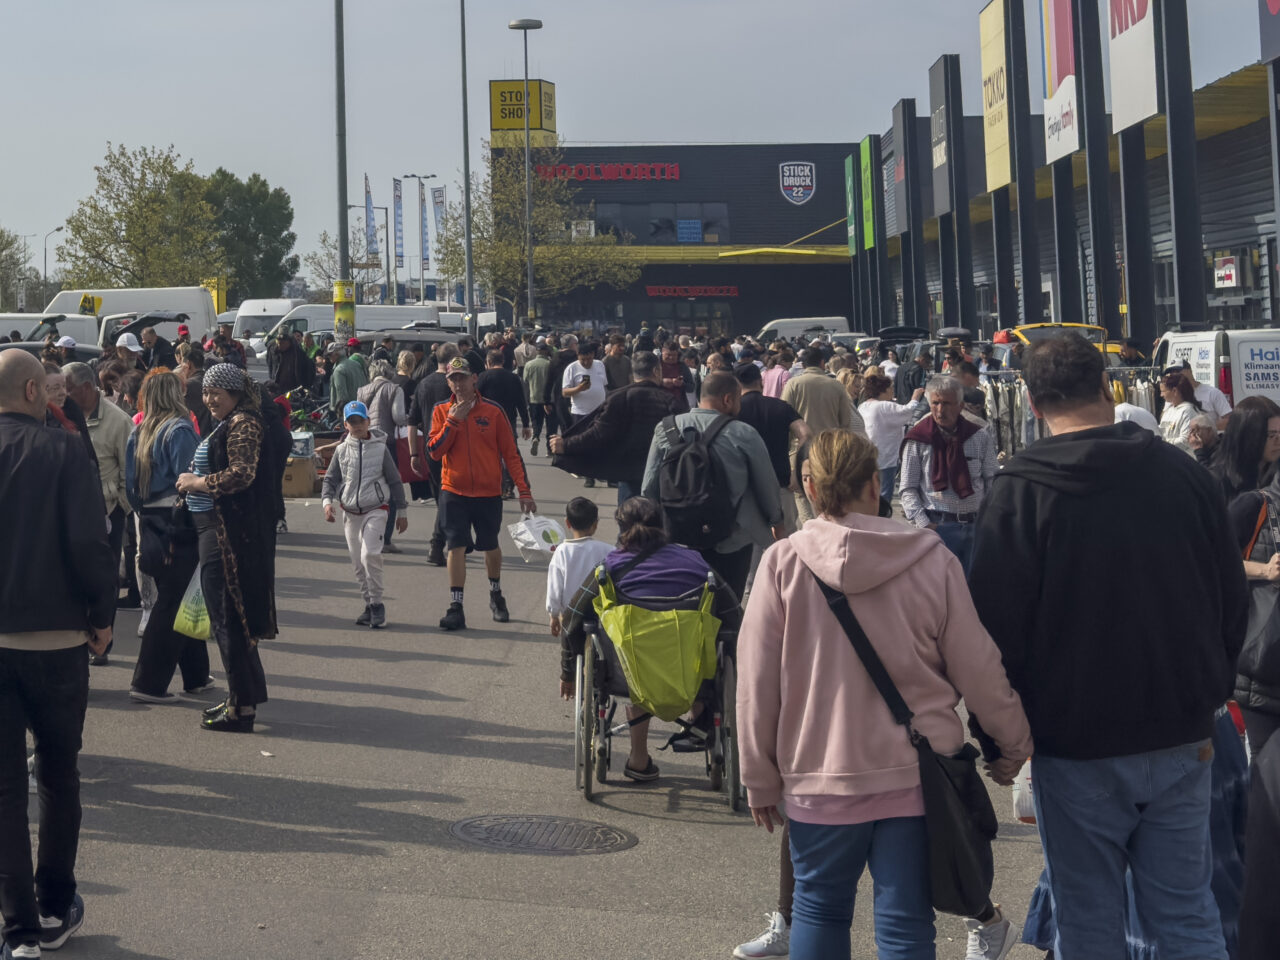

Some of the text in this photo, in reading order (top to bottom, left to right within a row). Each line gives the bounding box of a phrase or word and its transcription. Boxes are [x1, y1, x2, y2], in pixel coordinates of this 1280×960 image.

[536, 163, 680, 181] WOOLWORTH
[783, 165, 811, 177] STICK
[783, 176, 812, 186] DRUCK
[792, 187, 804, 197] 22
